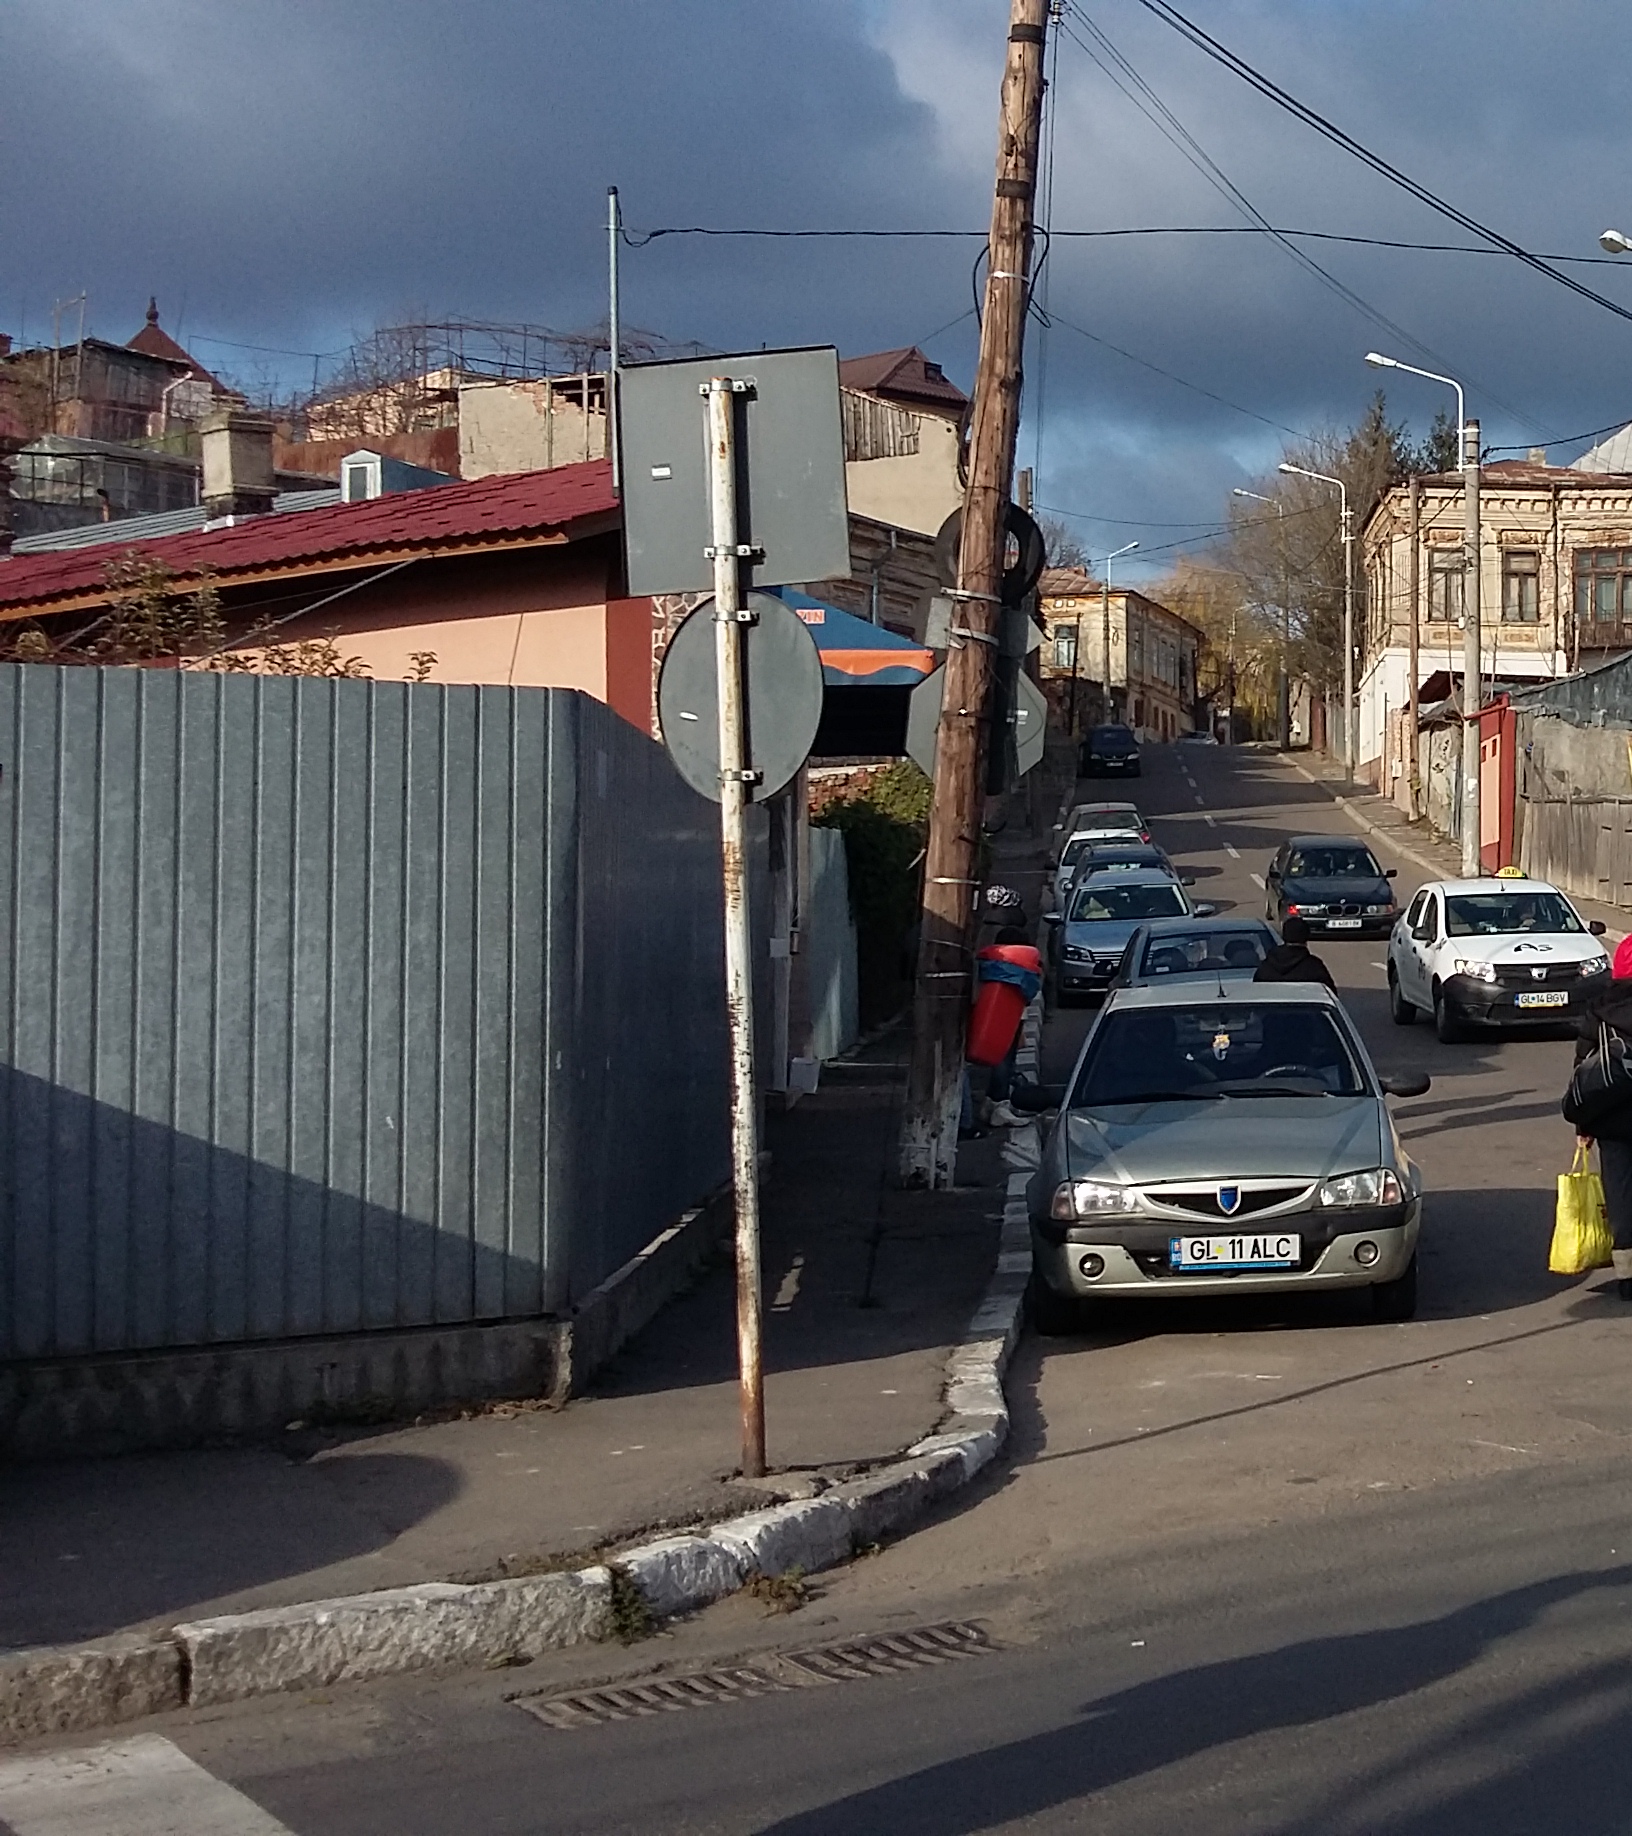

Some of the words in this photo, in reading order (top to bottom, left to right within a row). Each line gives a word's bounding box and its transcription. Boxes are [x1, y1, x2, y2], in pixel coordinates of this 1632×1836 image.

[1520, 994, 1533, 1004] GL
[1536, 994, 1545, 1003] 14
[1546, 993, 1566, 1003] BGV
[1190, 1240, 1219, 1260] GL
[1228, 1238, 1244, 1259] 11
[1250, 1237, 1291, 1258] ALC
